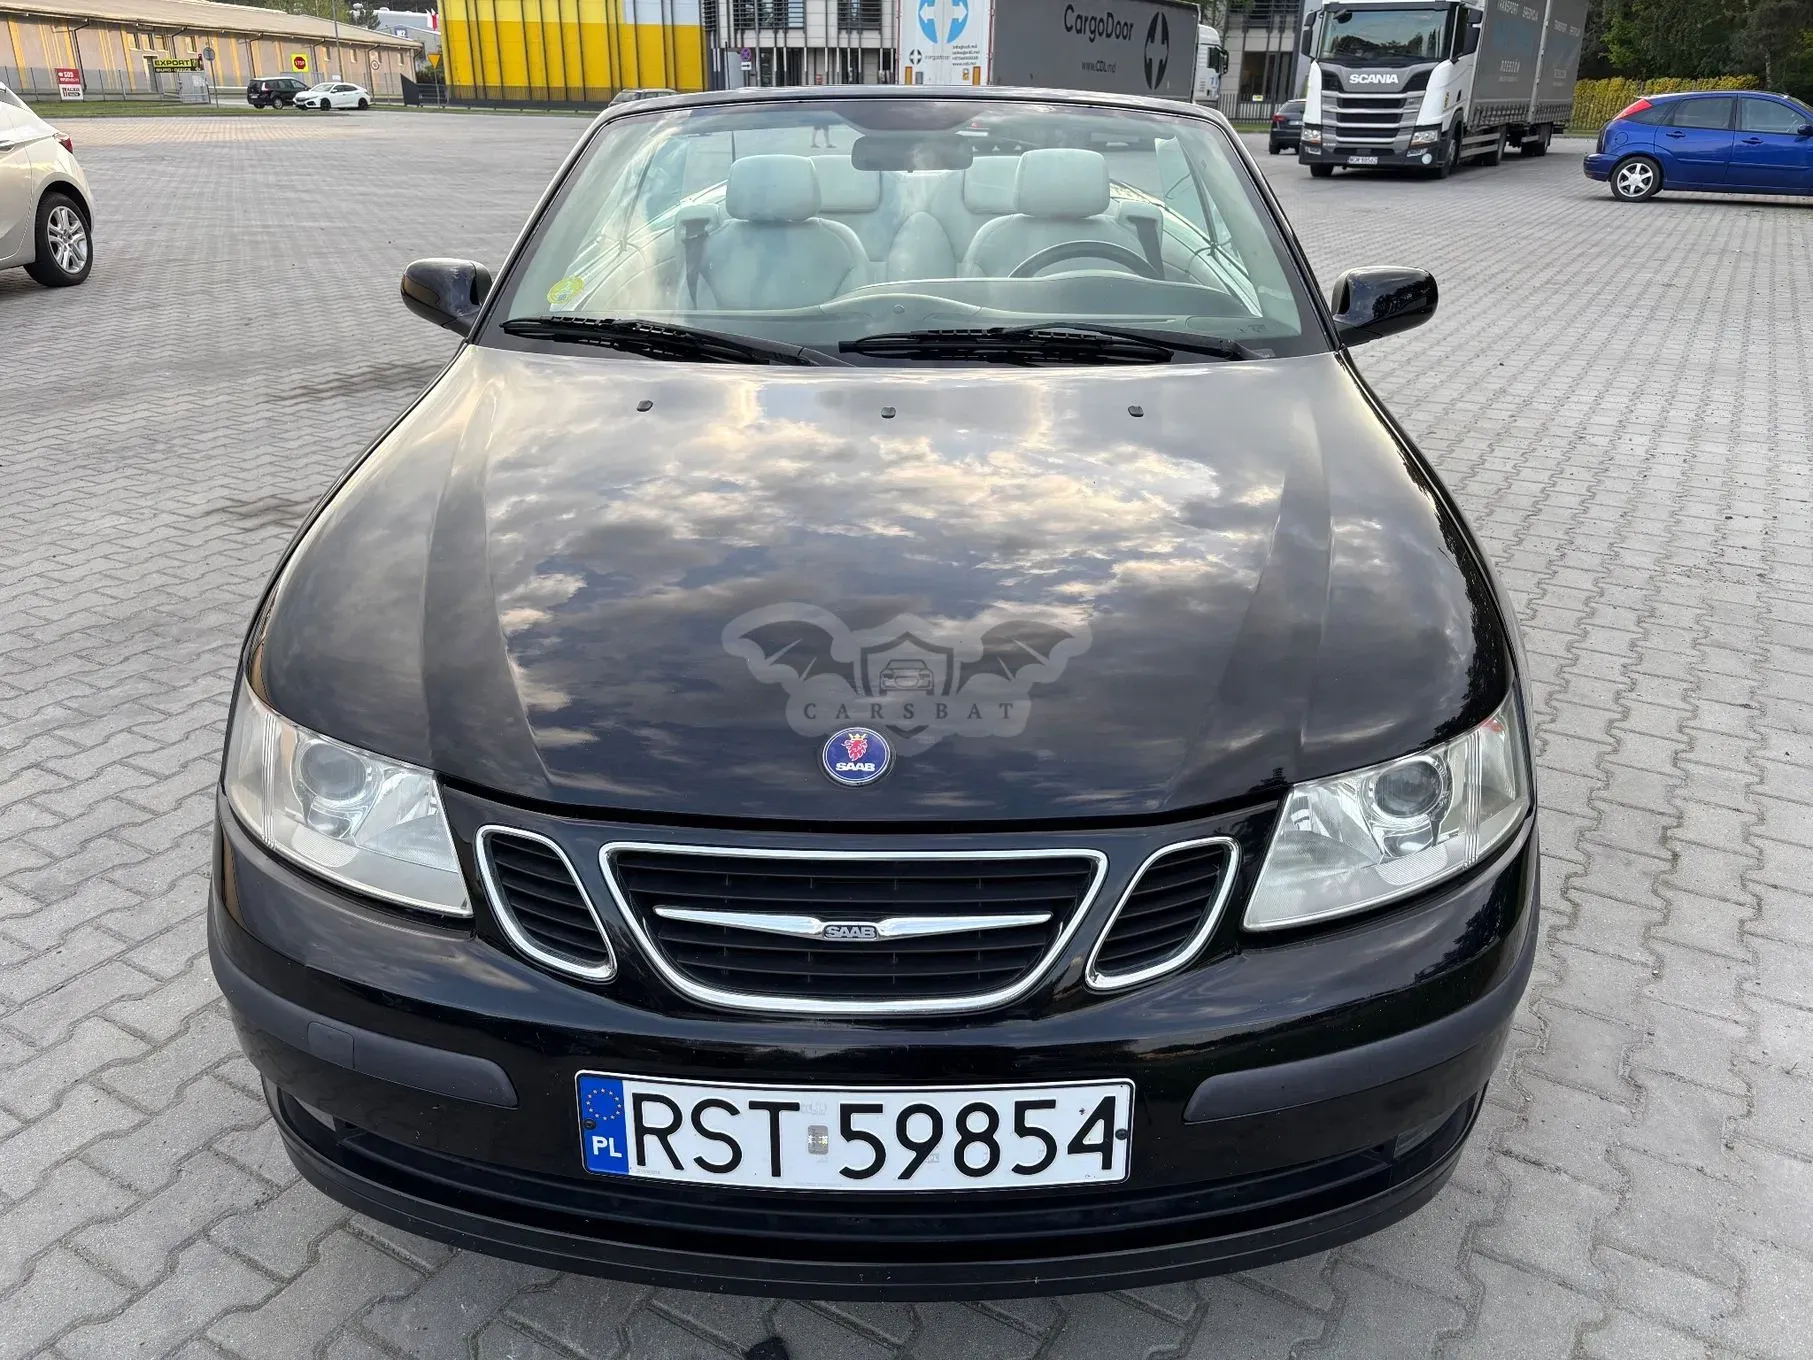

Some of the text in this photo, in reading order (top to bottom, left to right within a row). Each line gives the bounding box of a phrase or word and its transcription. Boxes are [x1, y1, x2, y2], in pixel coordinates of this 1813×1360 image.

[1064, 4, 1134, 43] CargoDoor
[1349, 73, 1399, 84] SCANIA
[835, 762, 876, 772] SAAB
[824, 925, 877, 939] SAAB
[631, 1092, 1118, 1181] RST 59854
[592, 1135, 623, 1158] PL
